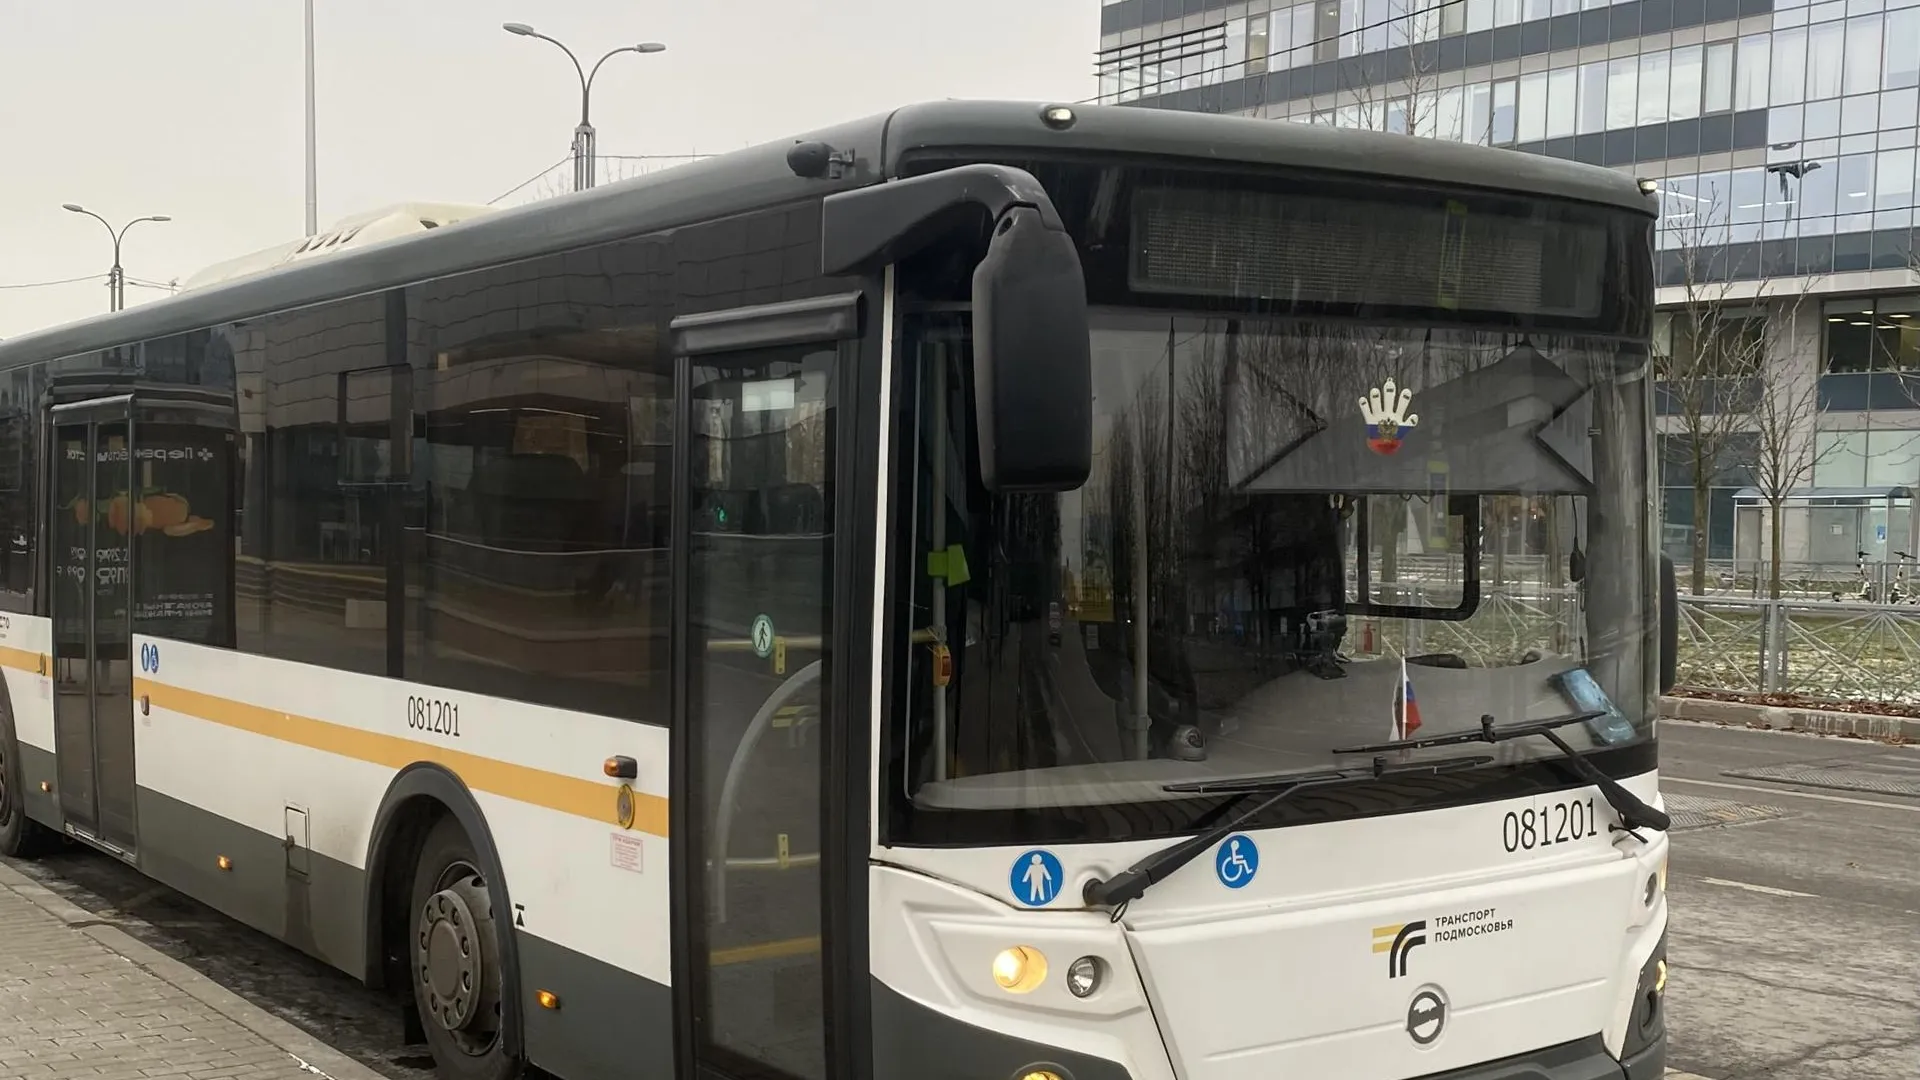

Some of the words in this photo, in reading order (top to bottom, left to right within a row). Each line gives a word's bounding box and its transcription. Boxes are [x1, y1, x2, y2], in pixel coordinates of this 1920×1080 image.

[407, 695, 460, 737] 081201
[1503, 797, 1597, 852] 081201
[1434, 919, 1513, 943] ПОДМОСКОВЬЯ
[1435, 907, 1496, 928] ТРАНСПОРТ
